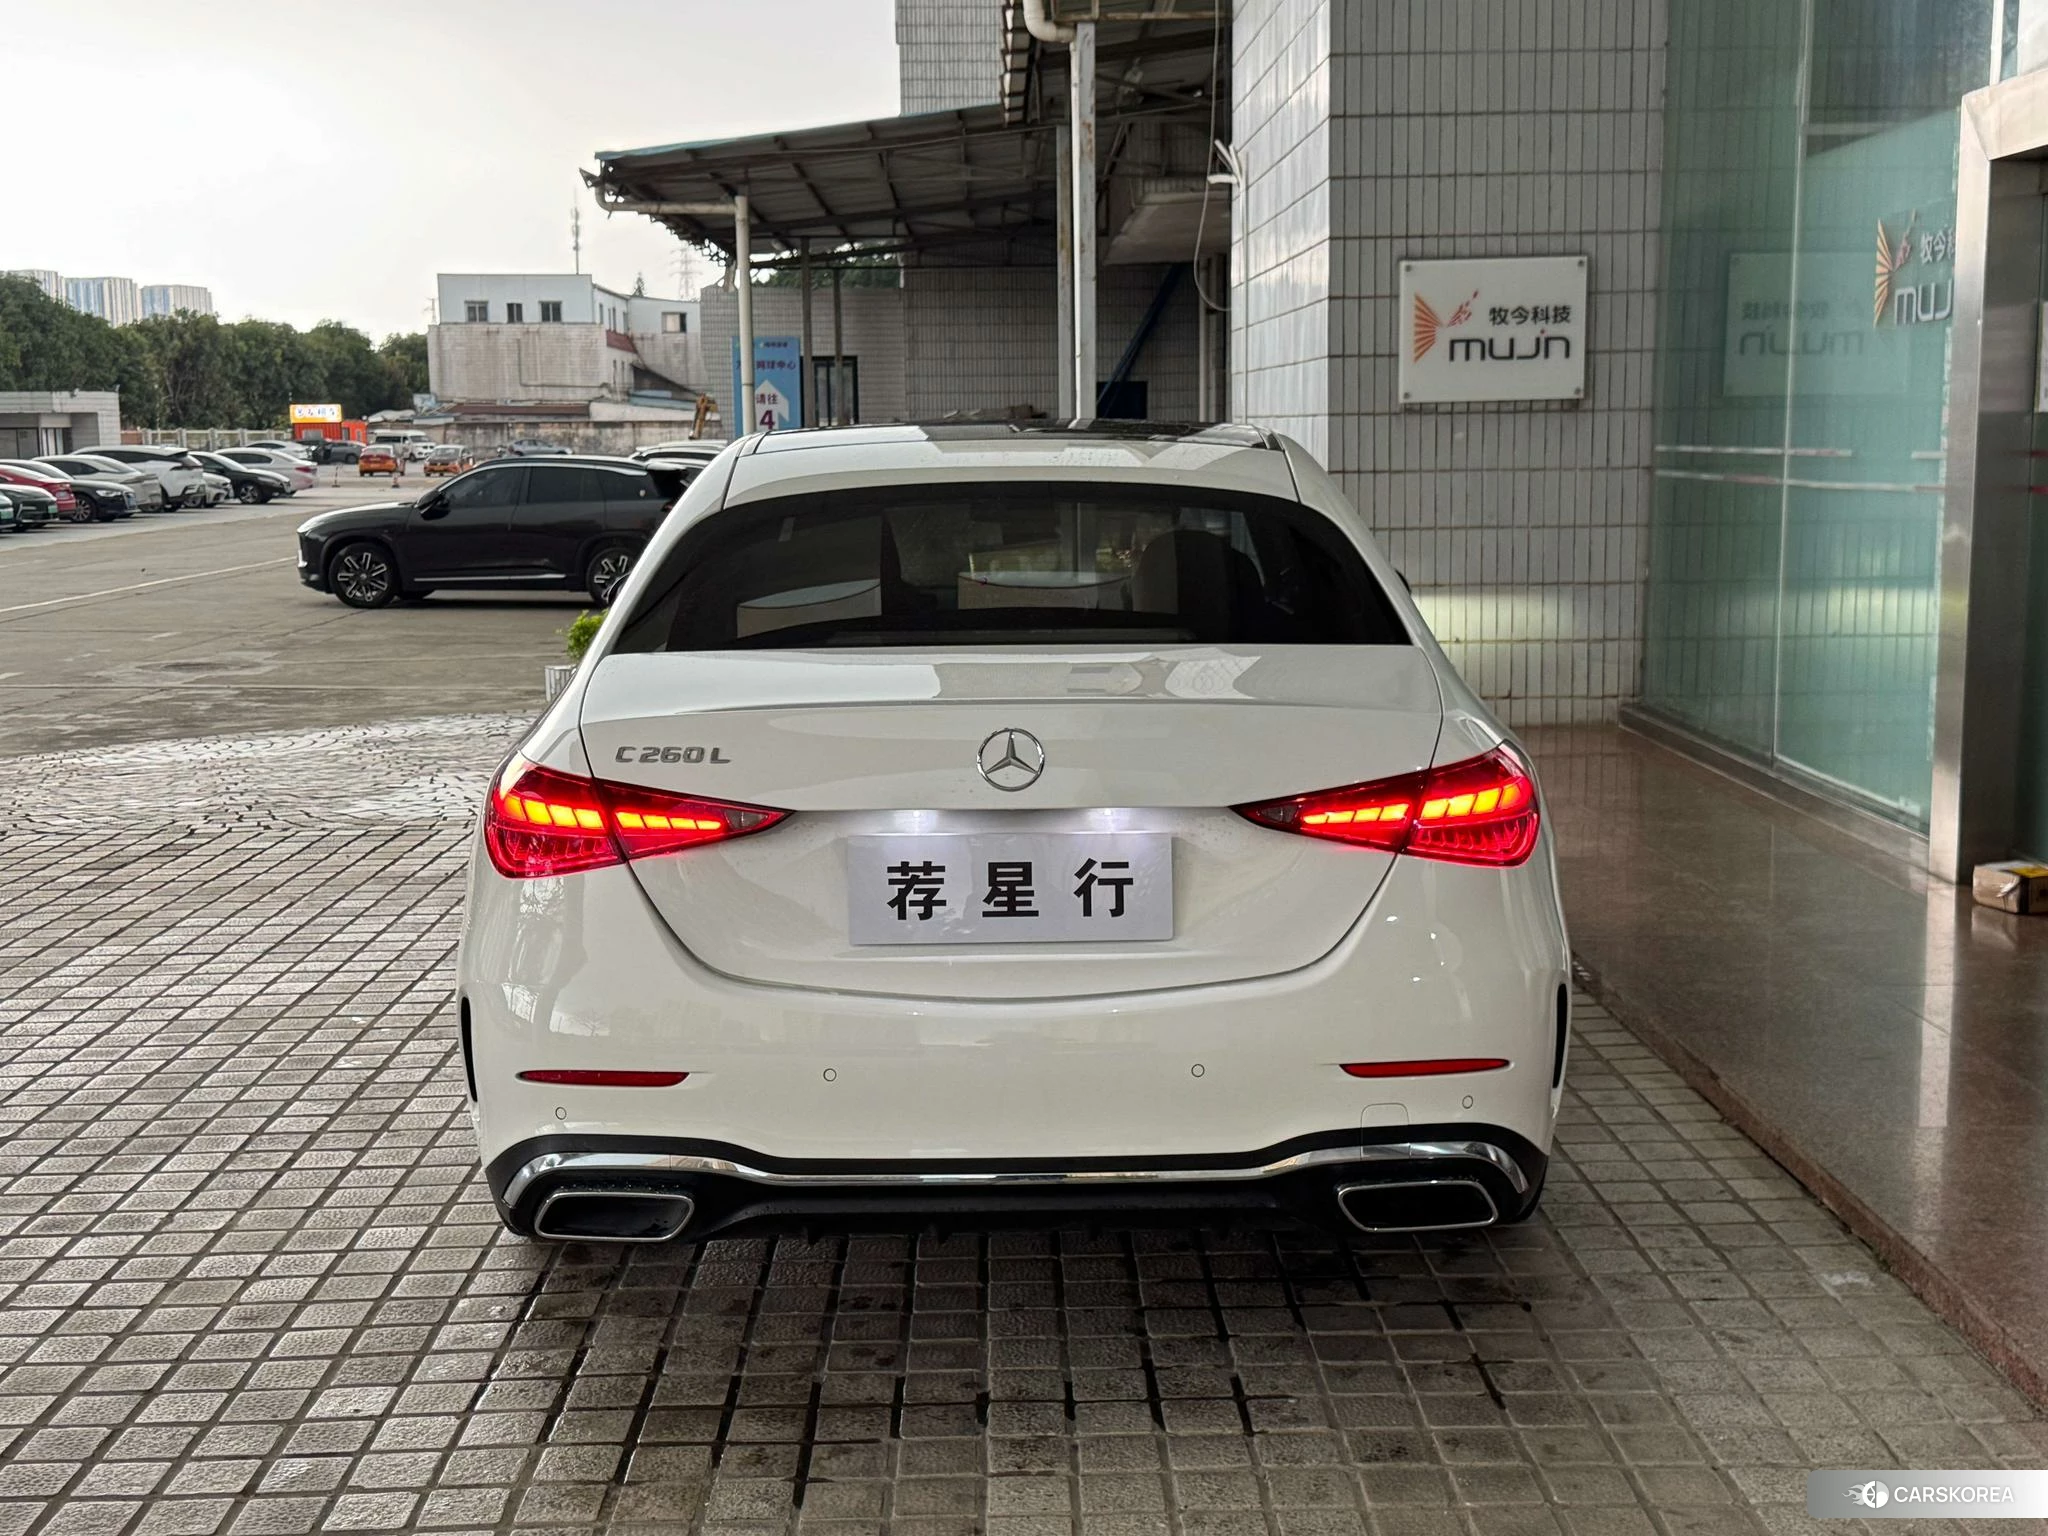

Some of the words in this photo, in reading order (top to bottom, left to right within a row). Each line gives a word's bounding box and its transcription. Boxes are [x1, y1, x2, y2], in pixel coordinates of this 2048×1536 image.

[1489, 305, 1571, 325] 牧今科技
[760, 410, 775, 430] 4
[887, 858, 1134, 921] 荐星行
